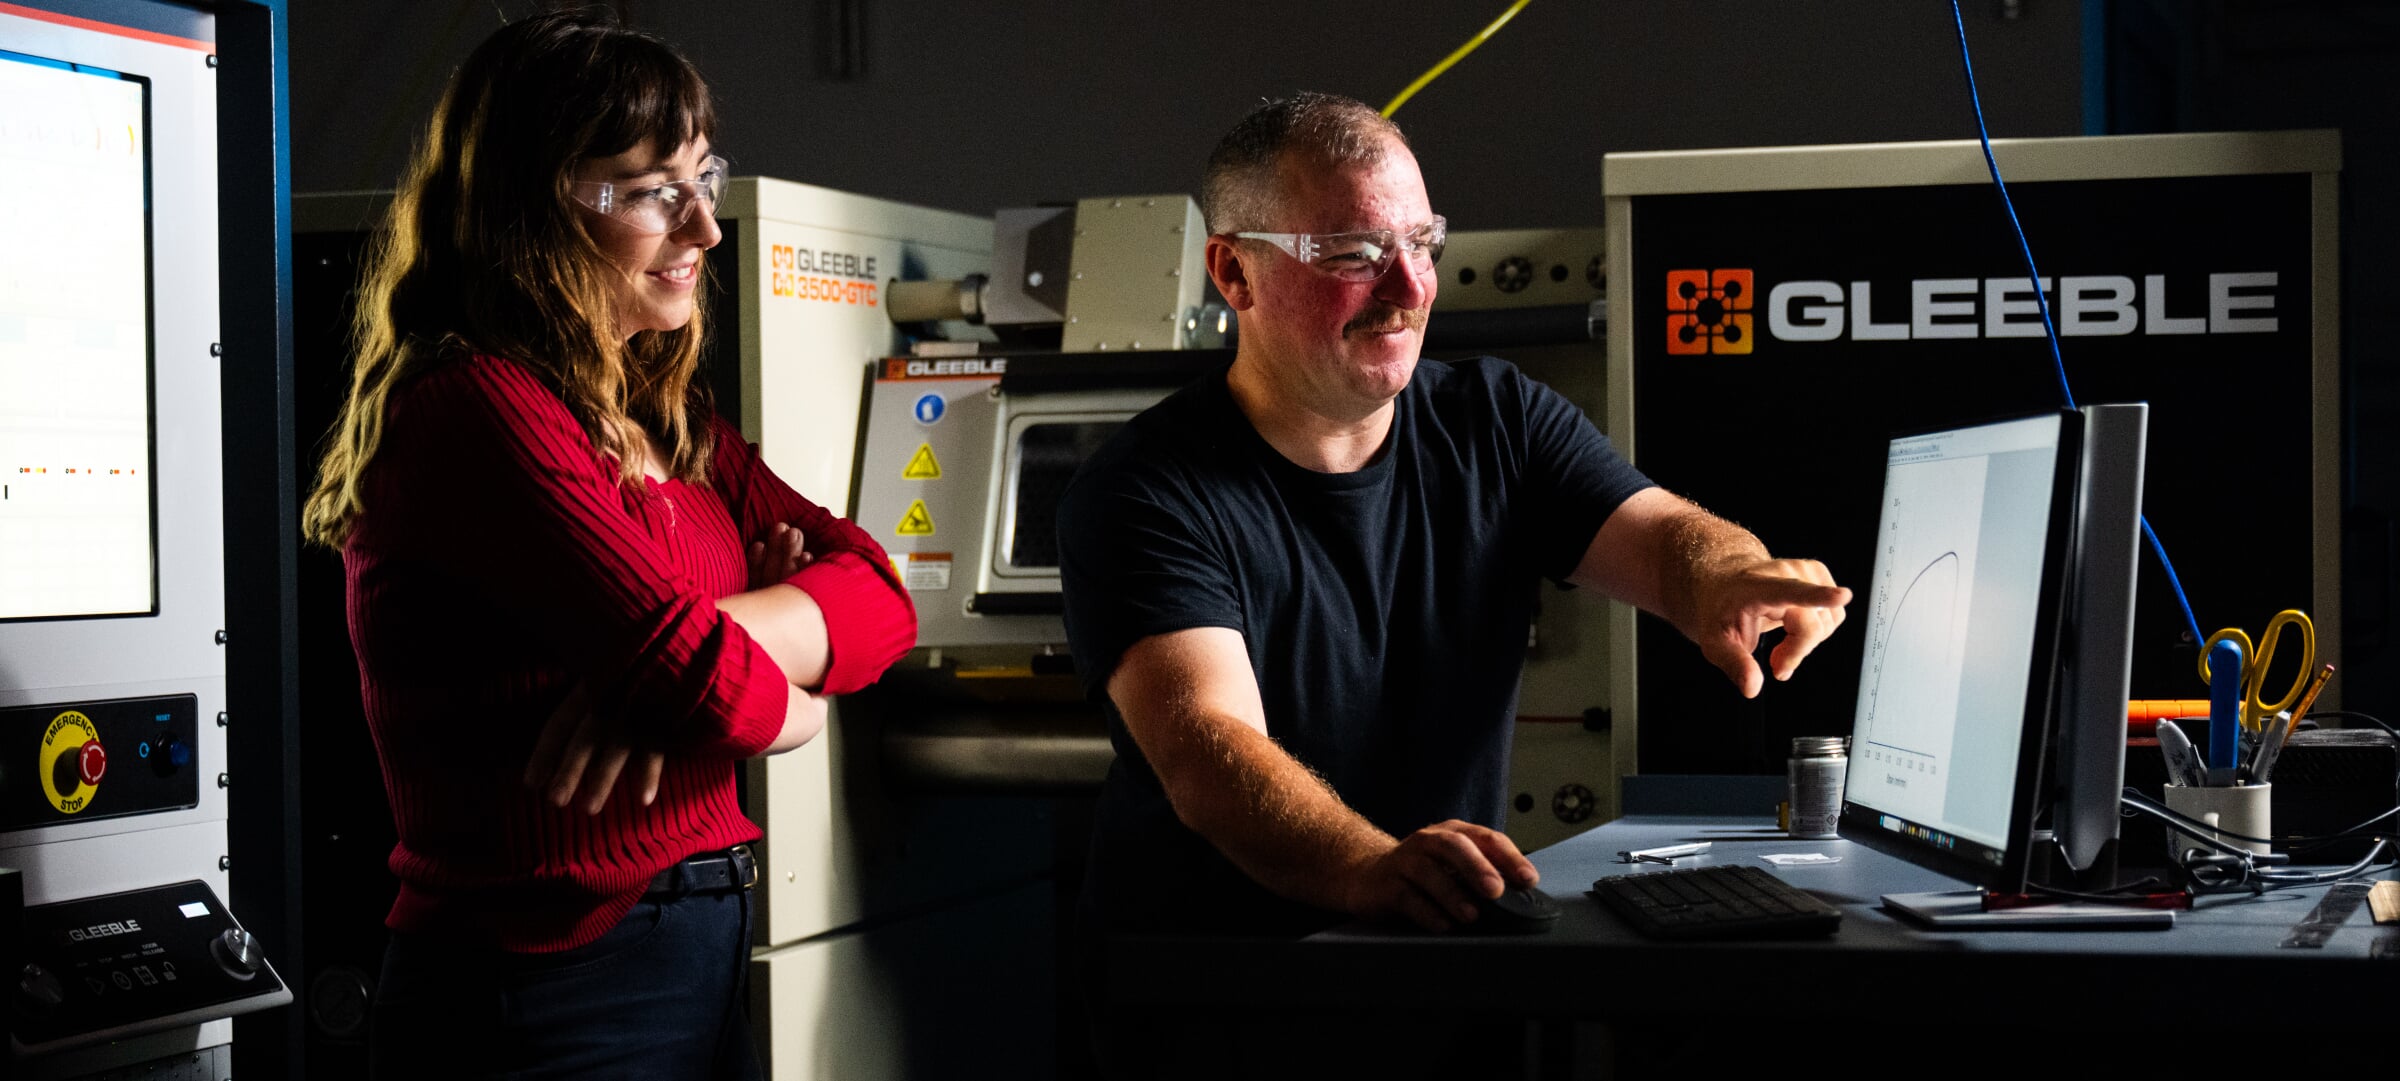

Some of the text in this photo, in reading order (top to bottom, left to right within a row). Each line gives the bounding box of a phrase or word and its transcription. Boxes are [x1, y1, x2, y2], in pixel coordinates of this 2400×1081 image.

[798, 248, 876, 280] GLEEBLE
[798, 276, 877, 307] 3500-GTC
[1768, 272, 2279, 342] GLEEBLE
[907, 358, 1006, 376] GLEEBLE
[61, 797, 83, 812] STOP
[69, 919, 142, 941] GLEEBLE
